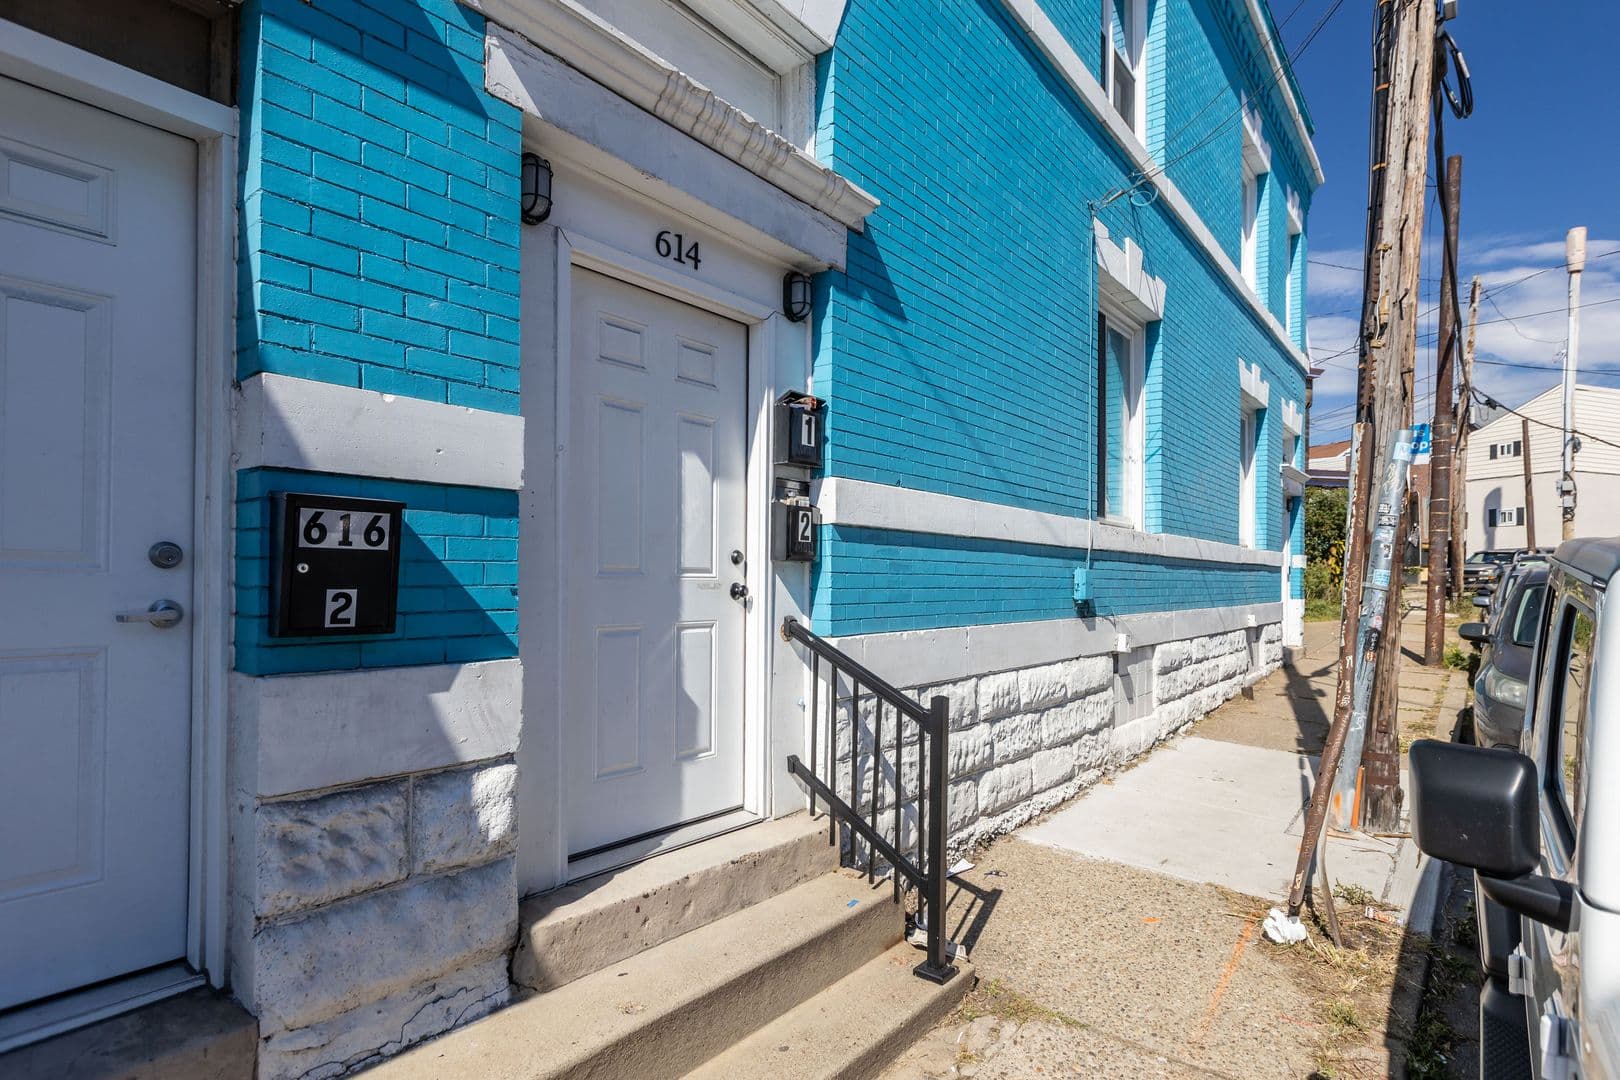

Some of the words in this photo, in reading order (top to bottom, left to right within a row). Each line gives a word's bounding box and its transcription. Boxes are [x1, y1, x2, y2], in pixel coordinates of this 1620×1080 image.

[655, 231, 701, 270] 614
[805, 417, 814, 445] 1
[303, 511, 386, 547] 616
[800, 512, 810, 541] 2
[329, 592, 353, 625] 2
